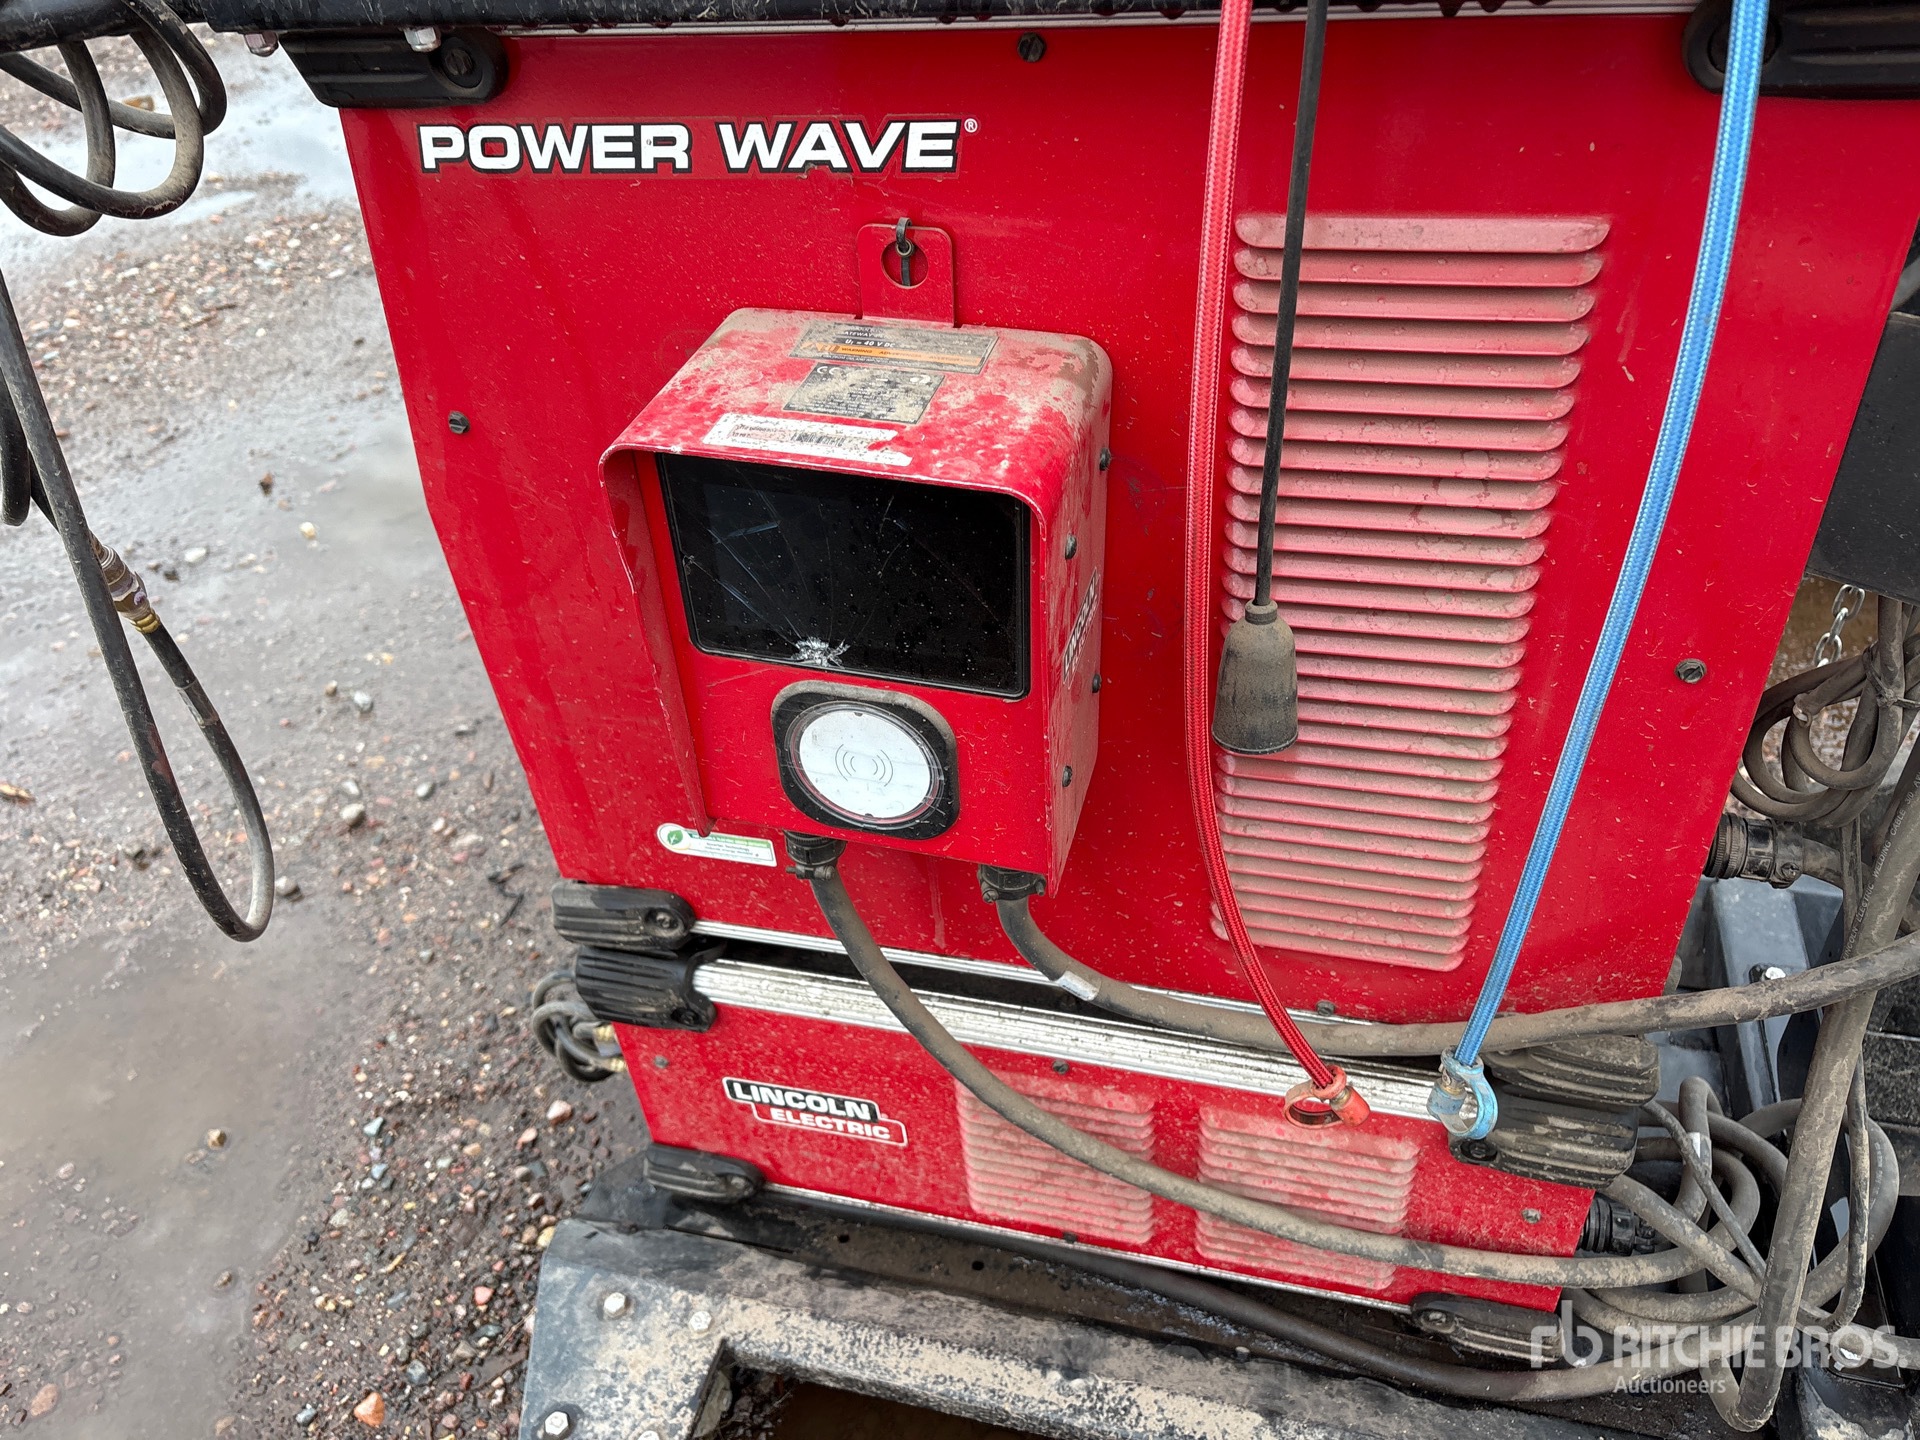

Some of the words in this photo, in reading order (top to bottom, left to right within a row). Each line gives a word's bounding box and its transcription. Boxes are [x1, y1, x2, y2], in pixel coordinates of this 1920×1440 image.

[419, 123, 691, 173] POWER
[1872, 838, 1892, 879] WELDING
[1889, 808, 1907, 837] CABLE
[733, 1081, 871, 1121] LINCOLN
[770, 1107, 891, 1140] ELECTRIC
